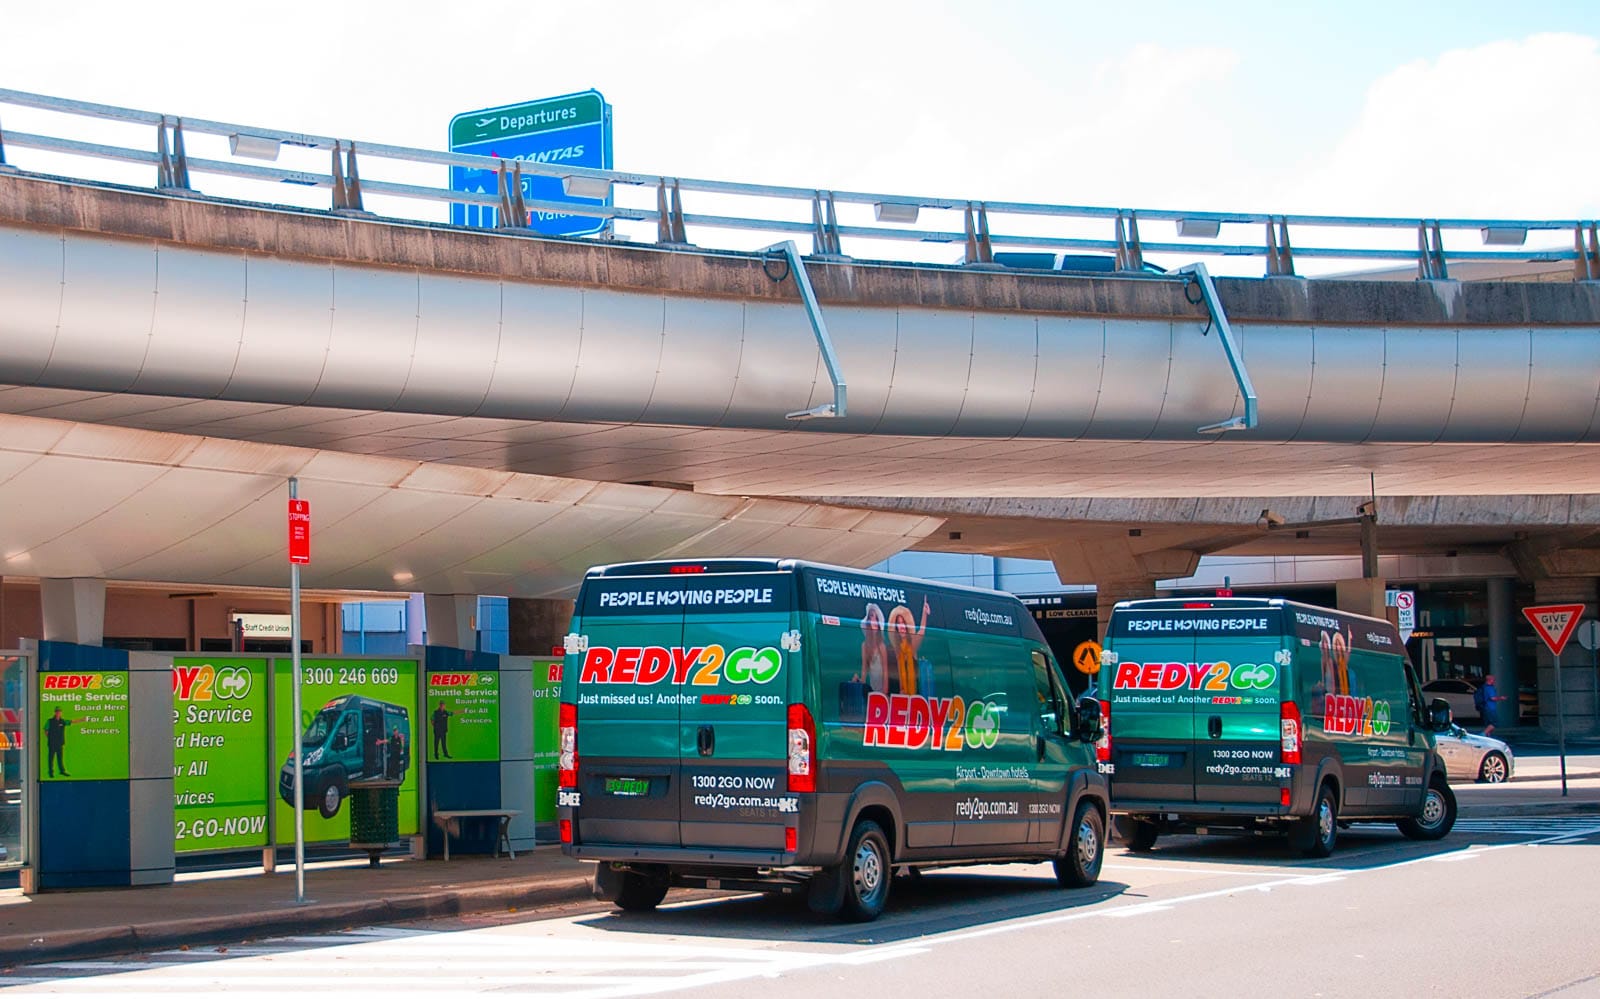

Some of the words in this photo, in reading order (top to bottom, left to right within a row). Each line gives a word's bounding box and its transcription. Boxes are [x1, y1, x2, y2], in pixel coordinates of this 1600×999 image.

[500, 107, 577, 130] Departures
[599, 591, 655, 607] PEOPLE
[656, 589, 712, 606] MOVING
[714, 588, 773, 604] PEOPLE
[817, 578, 849, 596] PEOPLE
[847, 582, 878, 600] MOVING
[877, 586, 906, 604] PEOPLE
[964, 607, 1013, 626] redy2go.com.au
[1541, 614, 1567, 624] GIVE
[245, 623, 258, 631] Staff
[259, 624, 275, 632] Credit
[275, 624, 290, 632] Union
[1128, 620, 1173, 631] PEOPLE
[1174, 620, 1220, 630] MOVING
[1221, 618, 1268, 630] PEOPLE
[339, 668, 366, 684] 246
[371, 668, 398, 684] 669
[42, 693, 82, 701] Shuttle
[85, 692, 128, 701] Service
[464, 688, 498, 696] Service
[578, 693, 599, 705] Just
[600, 693, 636, 705] missed
[637, 693, 653, 705] us!
[656, 693, 698, 705] Another
[755, 695, 783, 705] soon.
[1113, 695, 1131, 703] Just
[1132, 695, 1161, 704] missed
[1162, 695, 1176, 704] us!
[1177, 695, 1211, 704] Another
[1255, 696, 1278, 705] soon.
[186, 704, 253, 724] Service
[80, 727, 120, 735] Services
[189, 732, 225, 748] Here
[1212, 750, 1230, 758] 1300
[1231, 750, 1250, 758] 2GO
[1251, 751, 1273, 759] NOW
[187, 760, 208, 777] All
[956, 766, 977, 781] Airport
[981, 766, 1010, 779] Downtown
[1010, 766, 1029, 779] hotels
[1206, 764, 1273, 775] redy2go.com.au
[692, 775, 717, 788] 1300
[718, 776, 743, 789] 2GO
[745, 777, 775, 790] NOW
[173, 790, 215, 805] vices
[694, 793, 778, 809] redy2go.com.au
[956, 797, 1019, 819] redy2go.com.au
